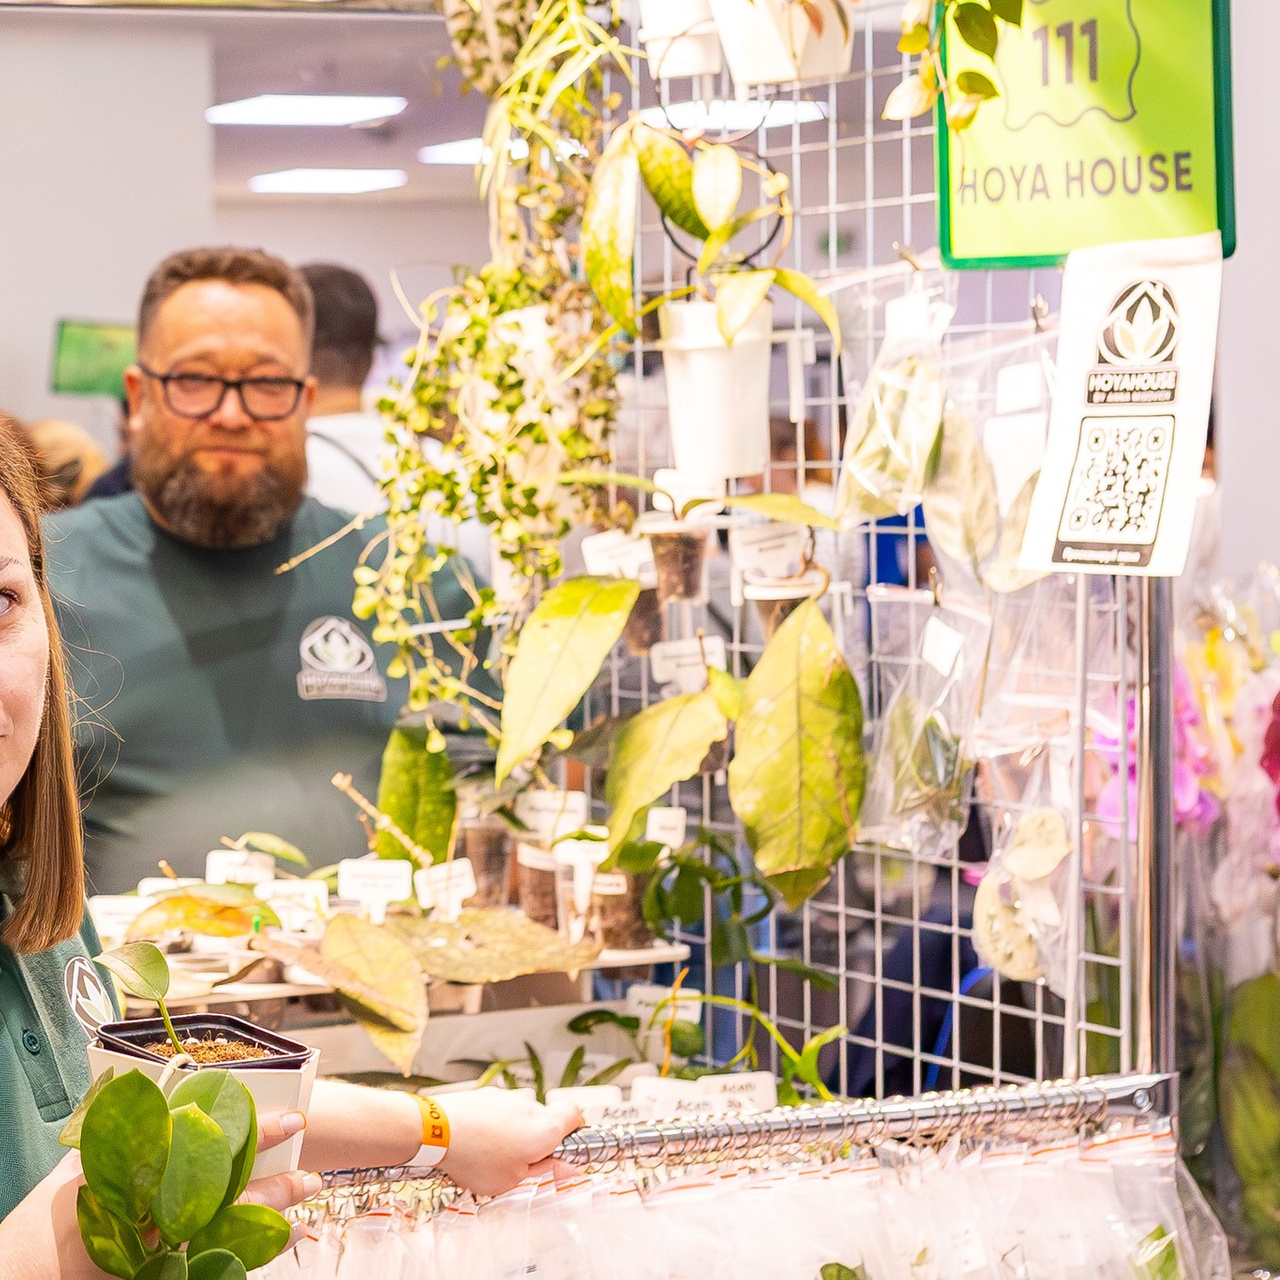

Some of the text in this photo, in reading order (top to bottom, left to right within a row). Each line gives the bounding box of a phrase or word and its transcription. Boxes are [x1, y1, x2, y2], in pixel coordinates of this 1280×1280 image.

[1032, 17, 1098, 87] 111
[960, 151, 1194, 205] HOYA HOUSE
